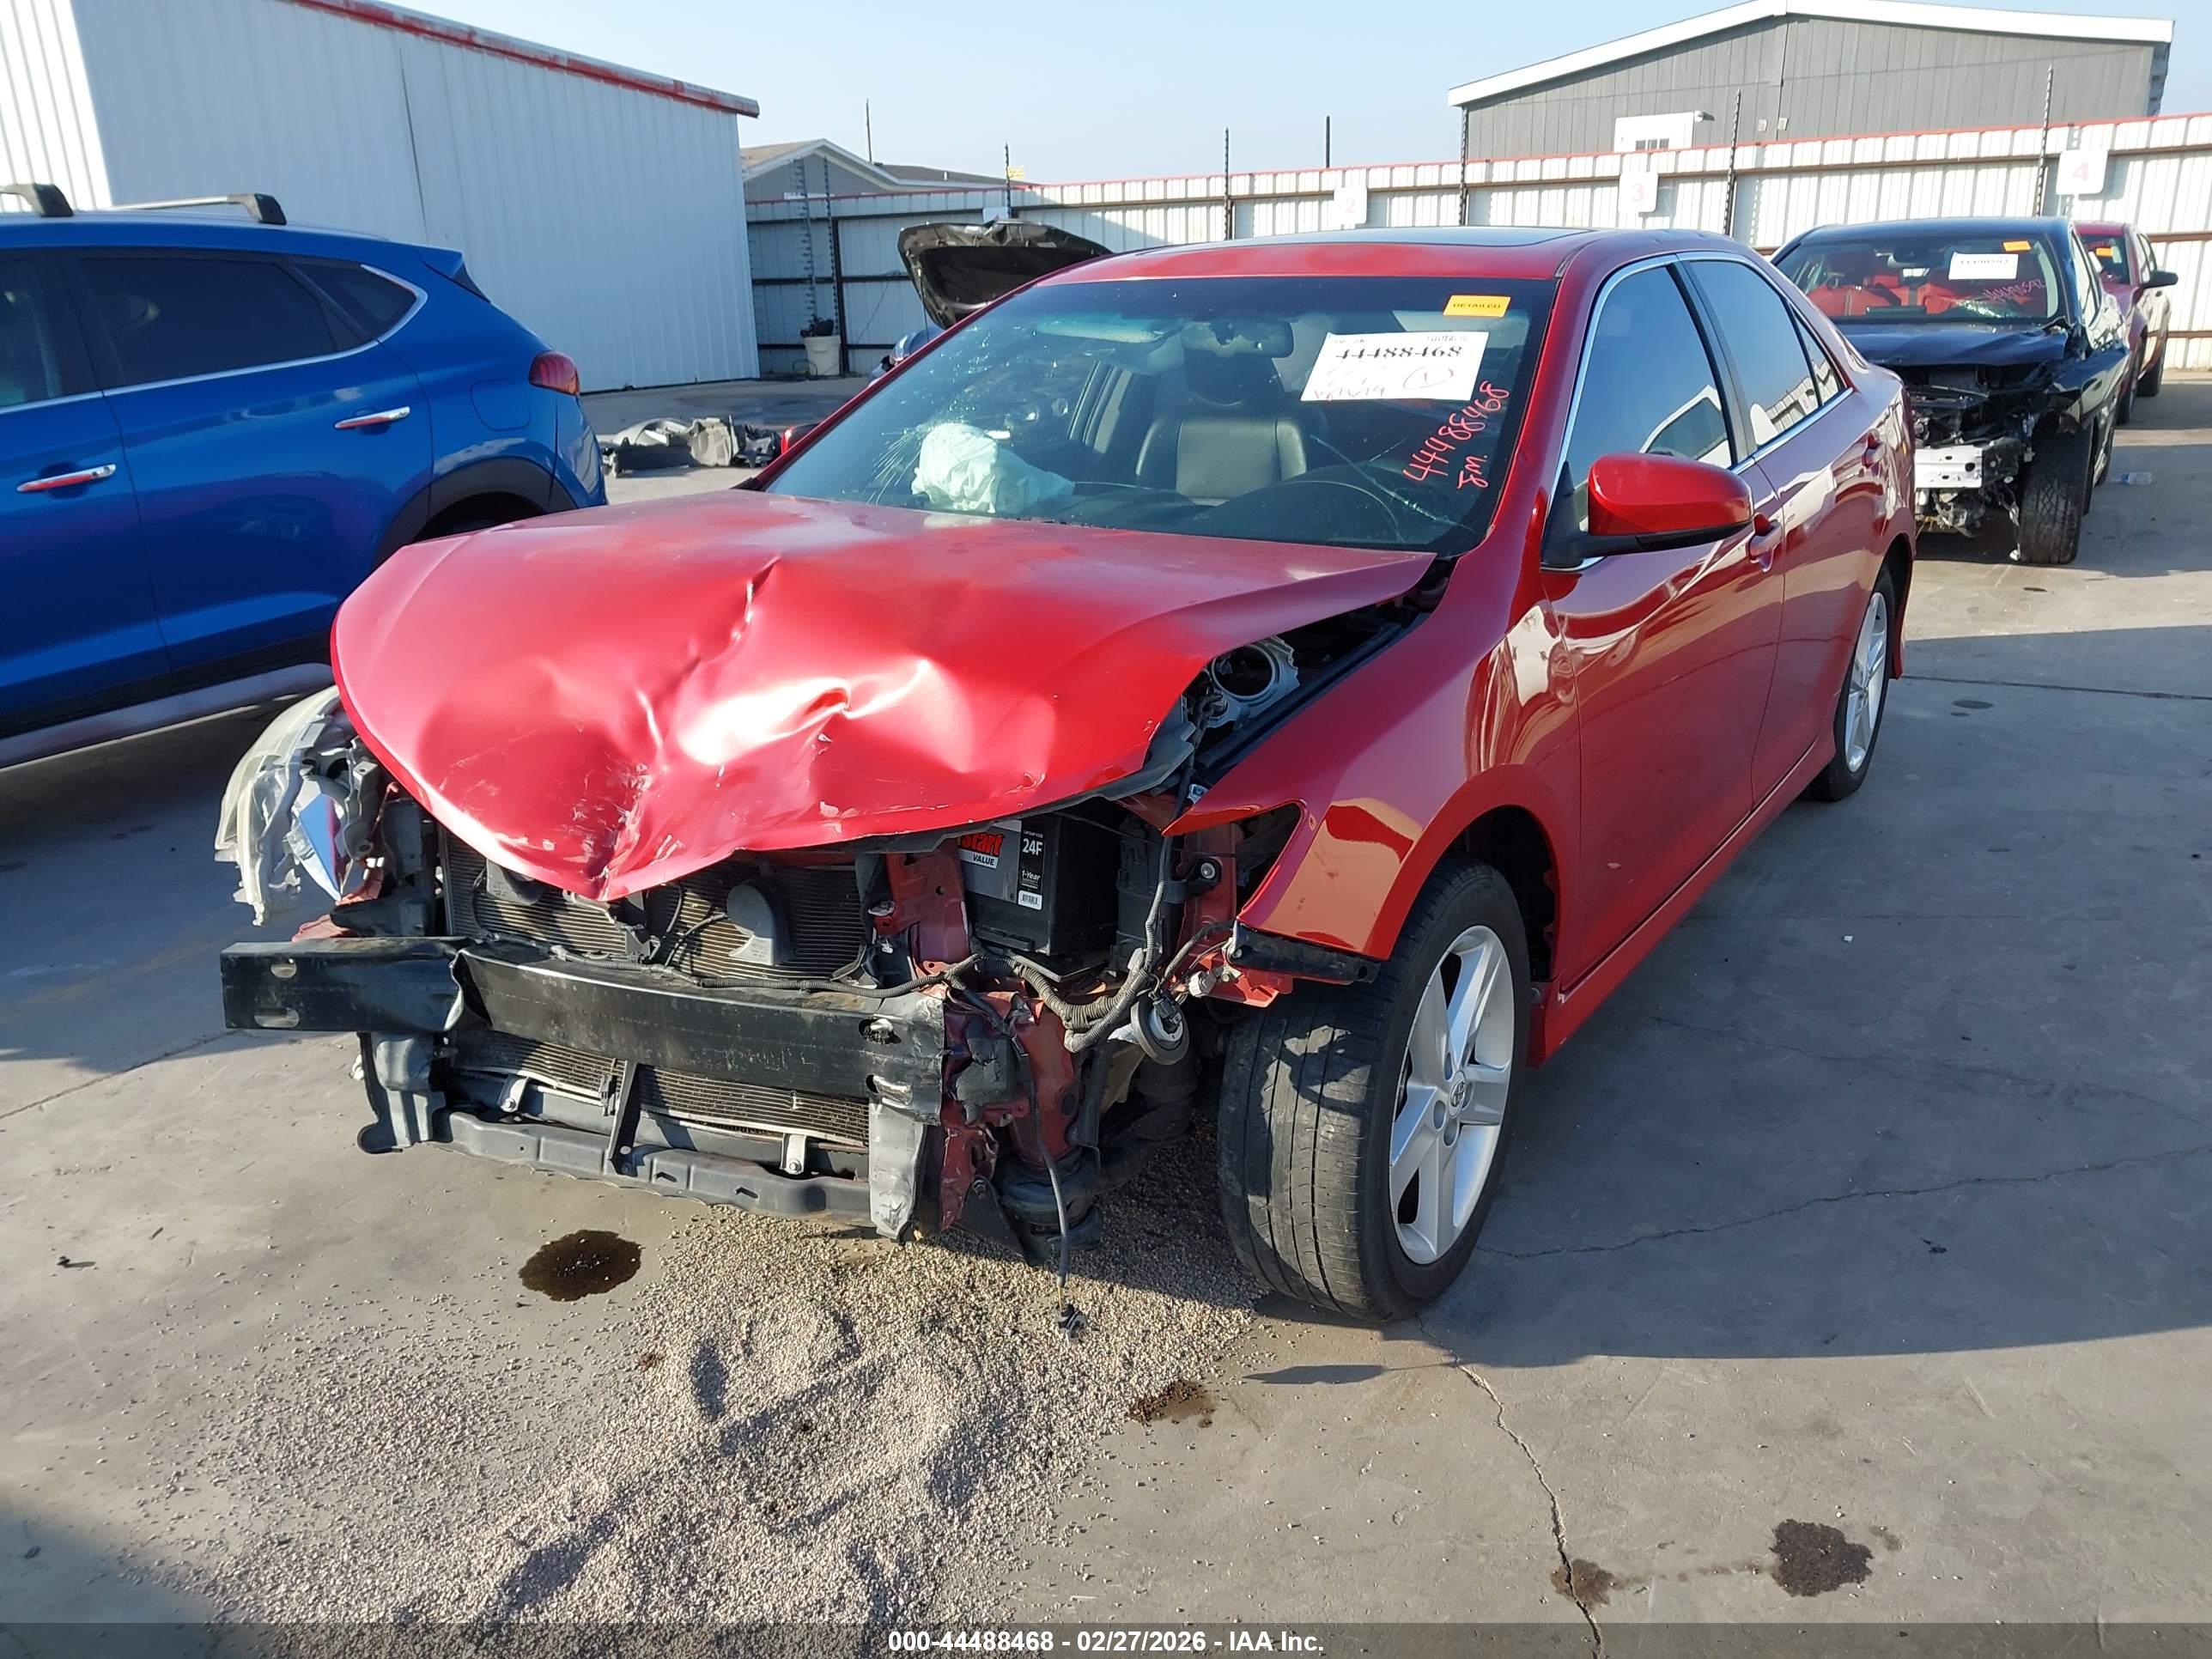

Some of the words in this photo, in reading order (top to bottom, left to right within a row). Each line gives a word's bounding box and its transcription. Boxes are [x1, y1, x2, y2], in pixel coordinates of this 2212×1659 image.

[2073, 162, 2090, 180] 4
[1632, 184, 1644, 201] 3
[1336, 346, 1462, 360] 44488468
[1402, 380, 1510, 481] 44488468
[1022, 838, 1043, 855] 24F
[973, 854, 995, 866] VALUE
